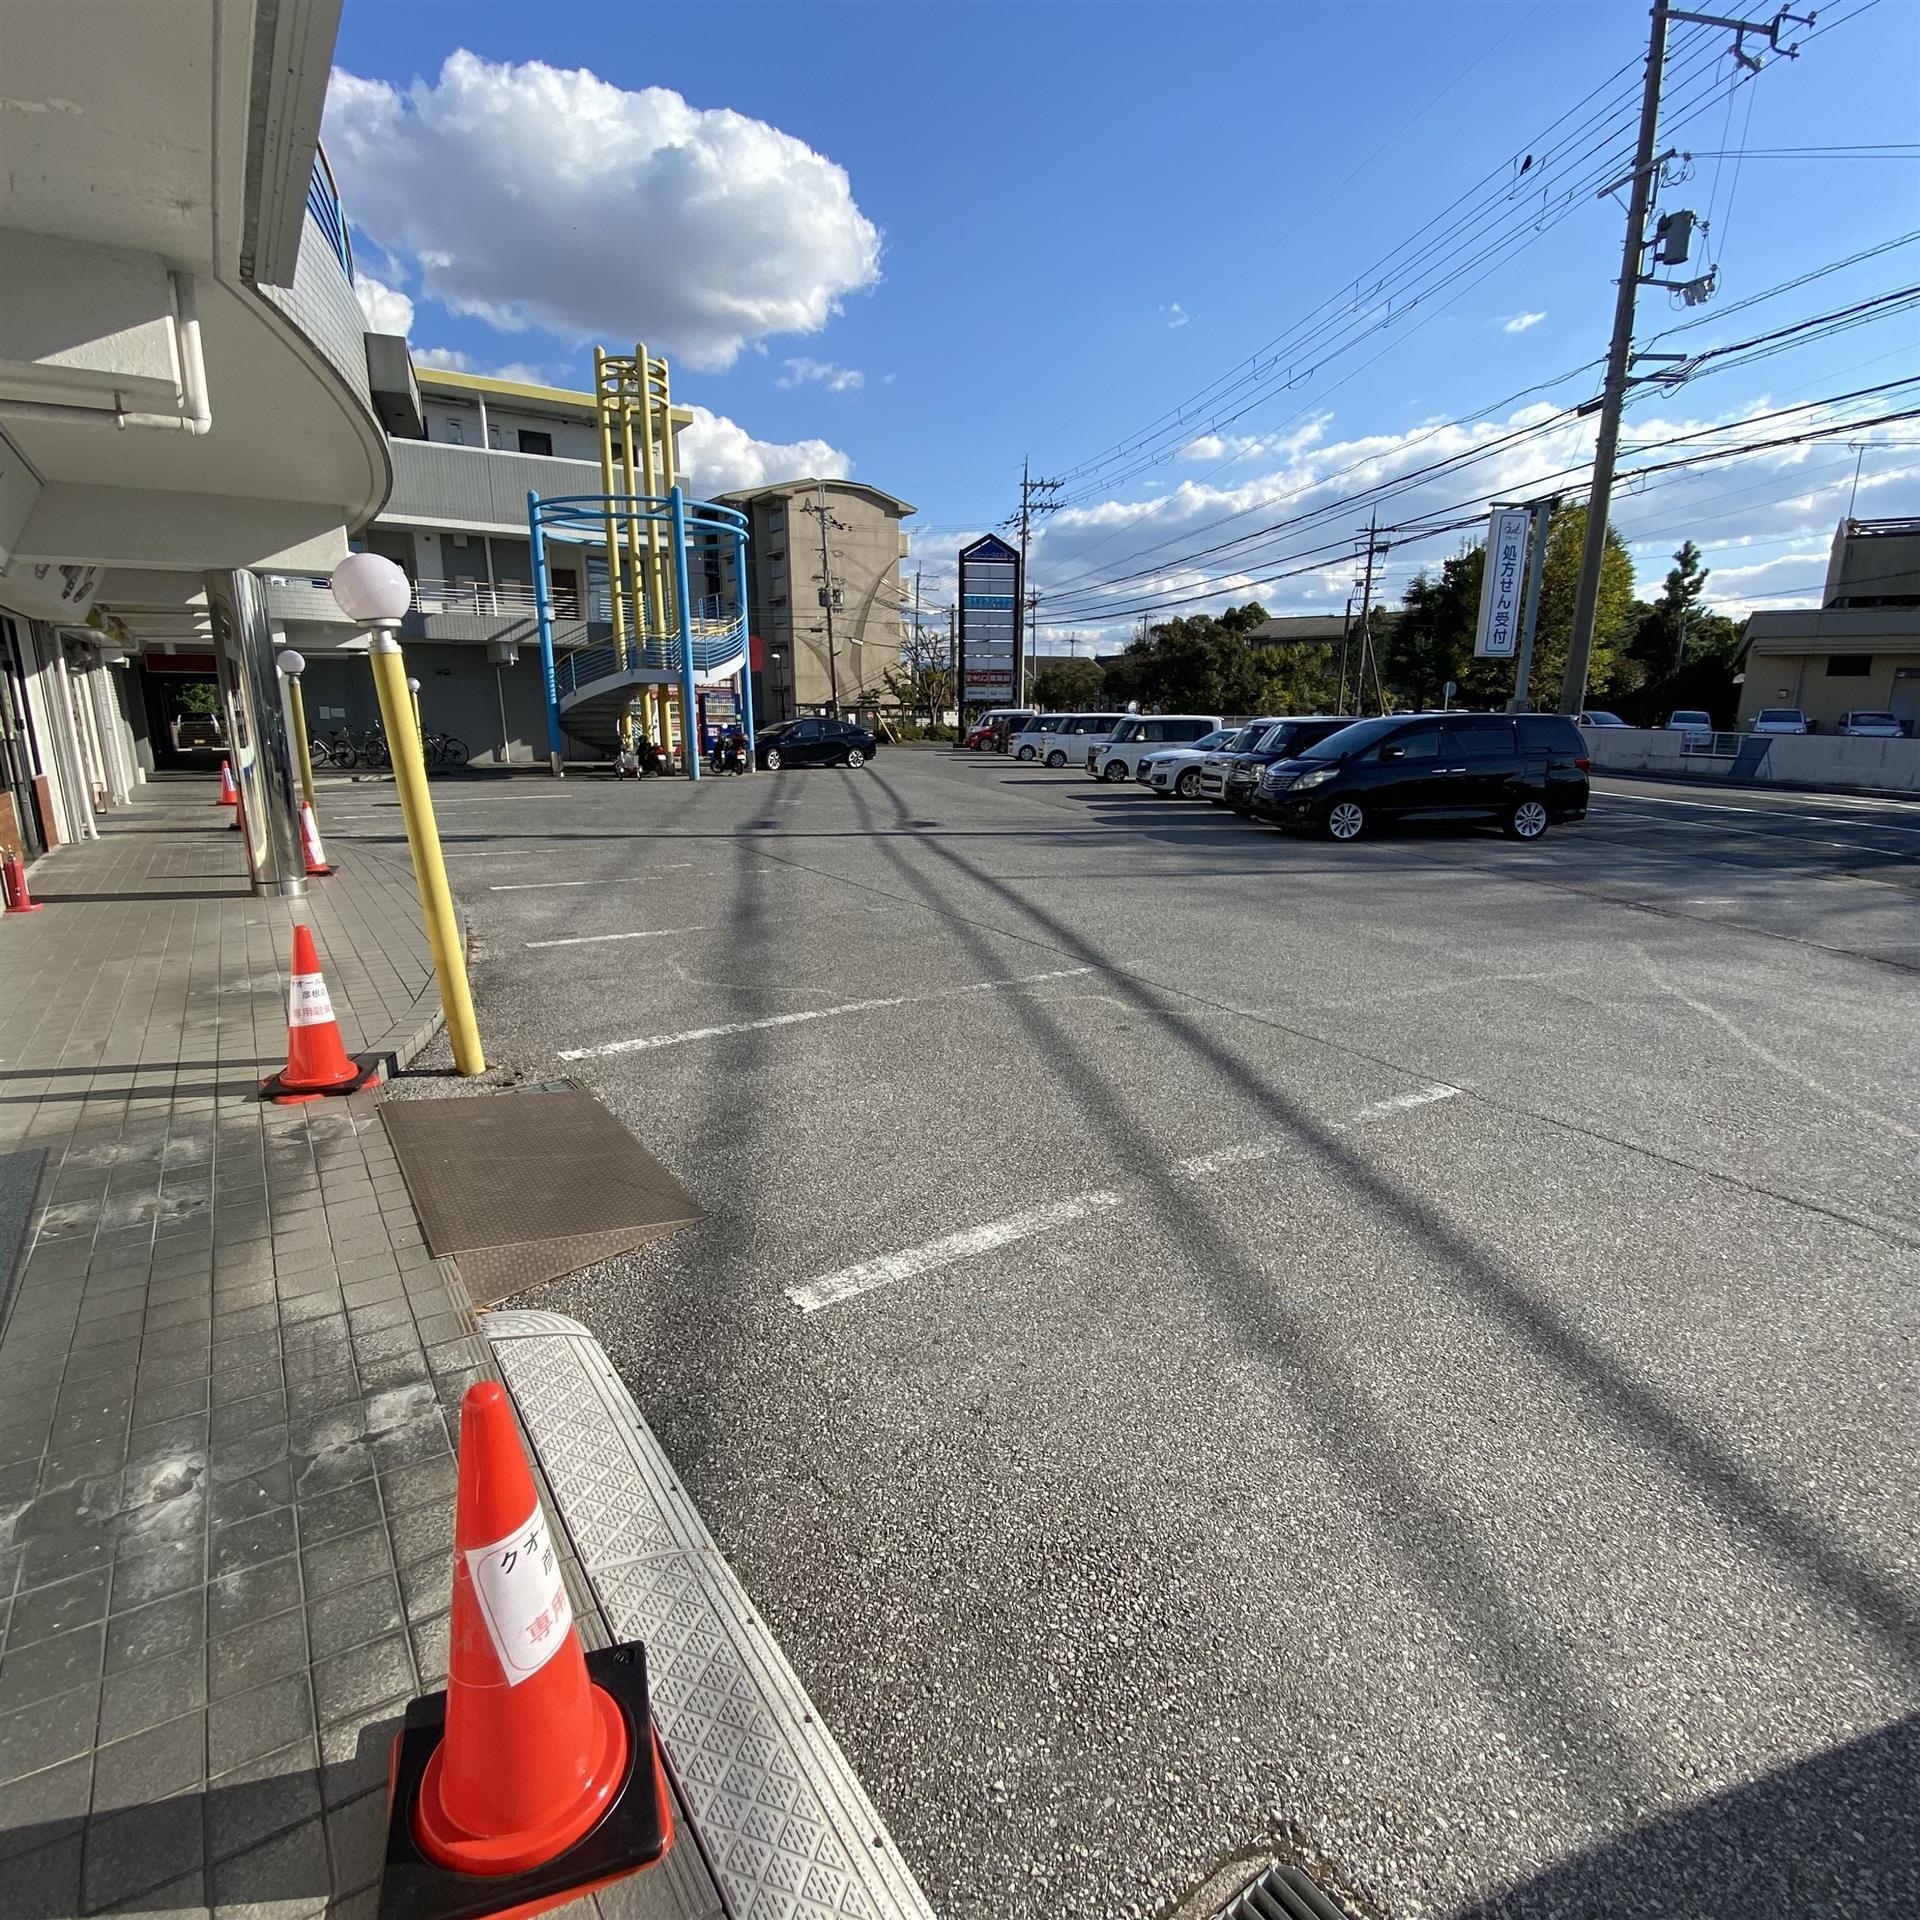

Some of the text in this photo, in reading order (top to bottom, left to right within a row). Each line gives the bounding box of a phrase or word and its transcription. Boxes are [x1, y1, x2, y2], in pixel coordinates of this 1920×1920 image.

[1493, 544, 1518, 645] 処方せん受付
